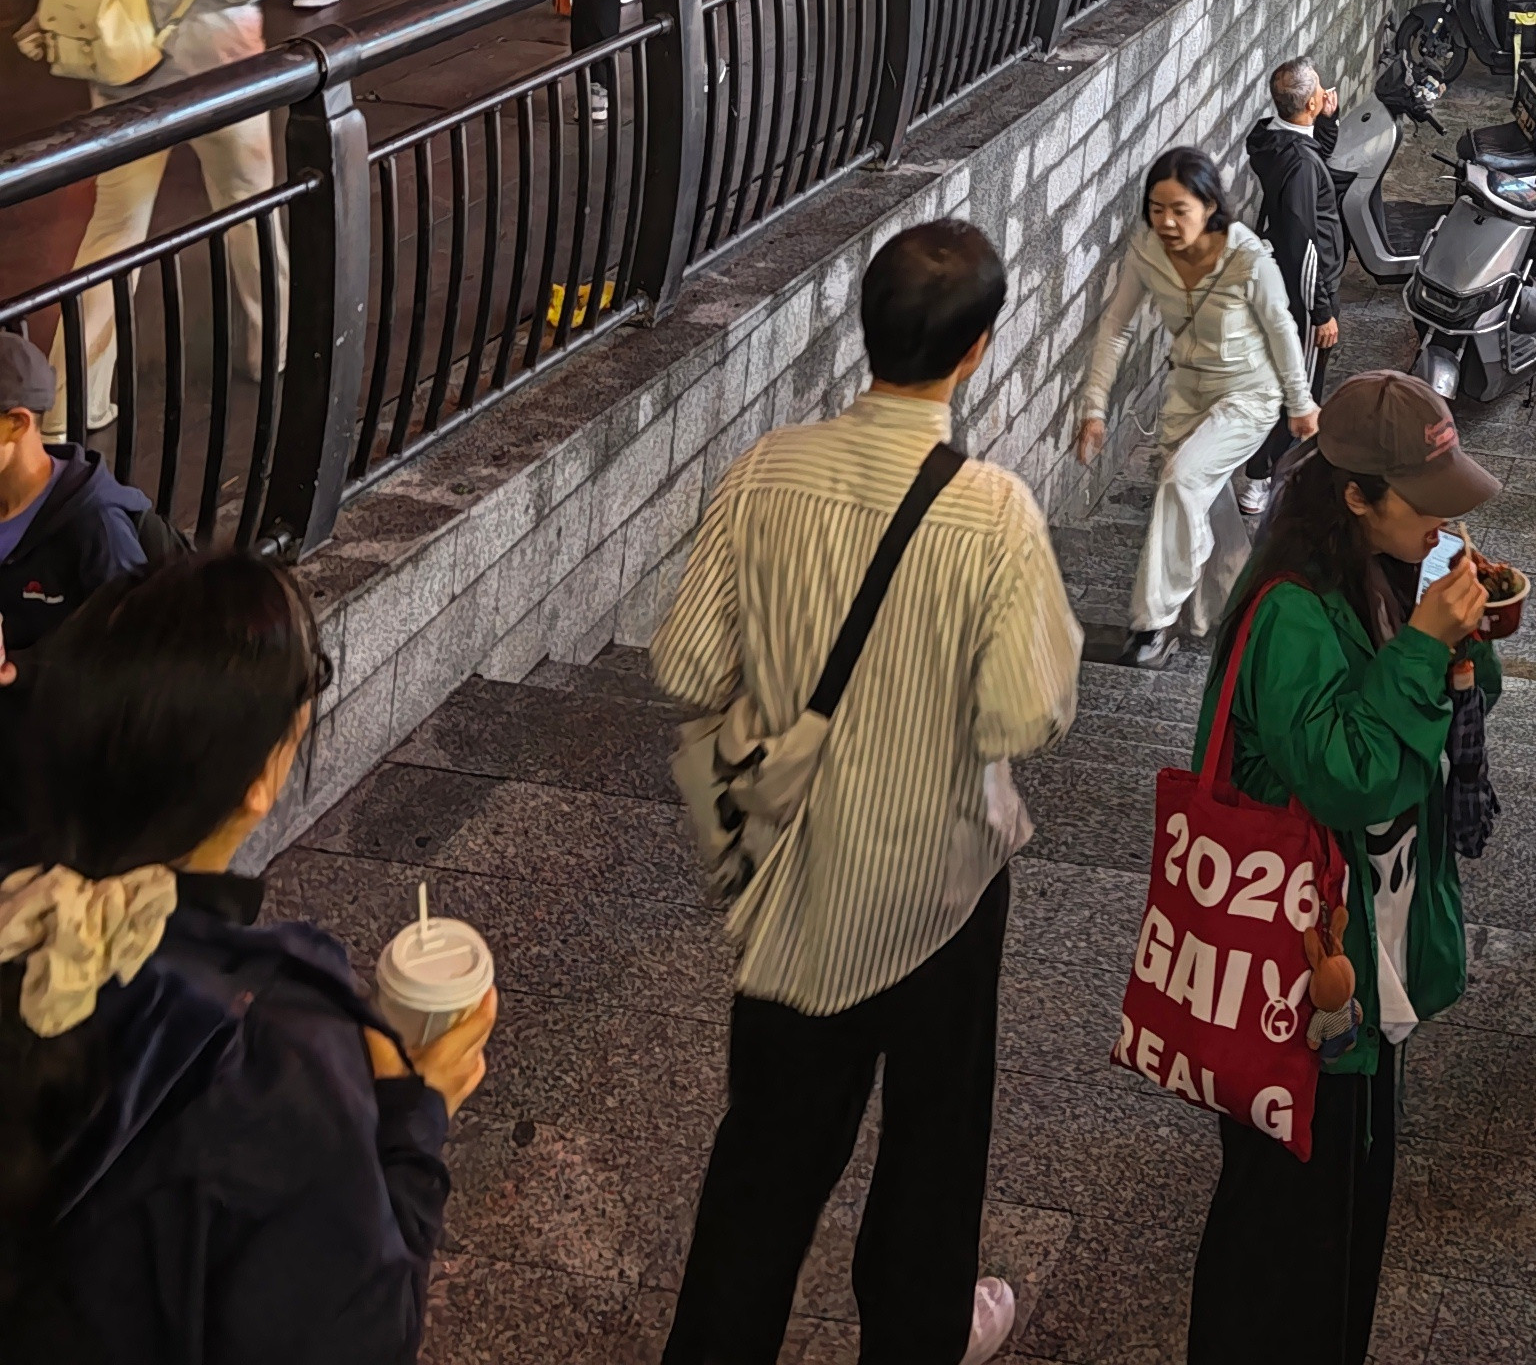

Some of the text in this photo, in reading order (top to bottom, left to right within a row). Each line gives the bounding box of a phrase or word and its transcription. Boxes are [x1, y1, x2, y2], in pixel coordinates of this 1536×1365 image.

[1164, 811, 1321, 933] 2026
[1134, 904, 1253, 1031] GAI
[1111, 1013, 1294, 1143] REAL G
